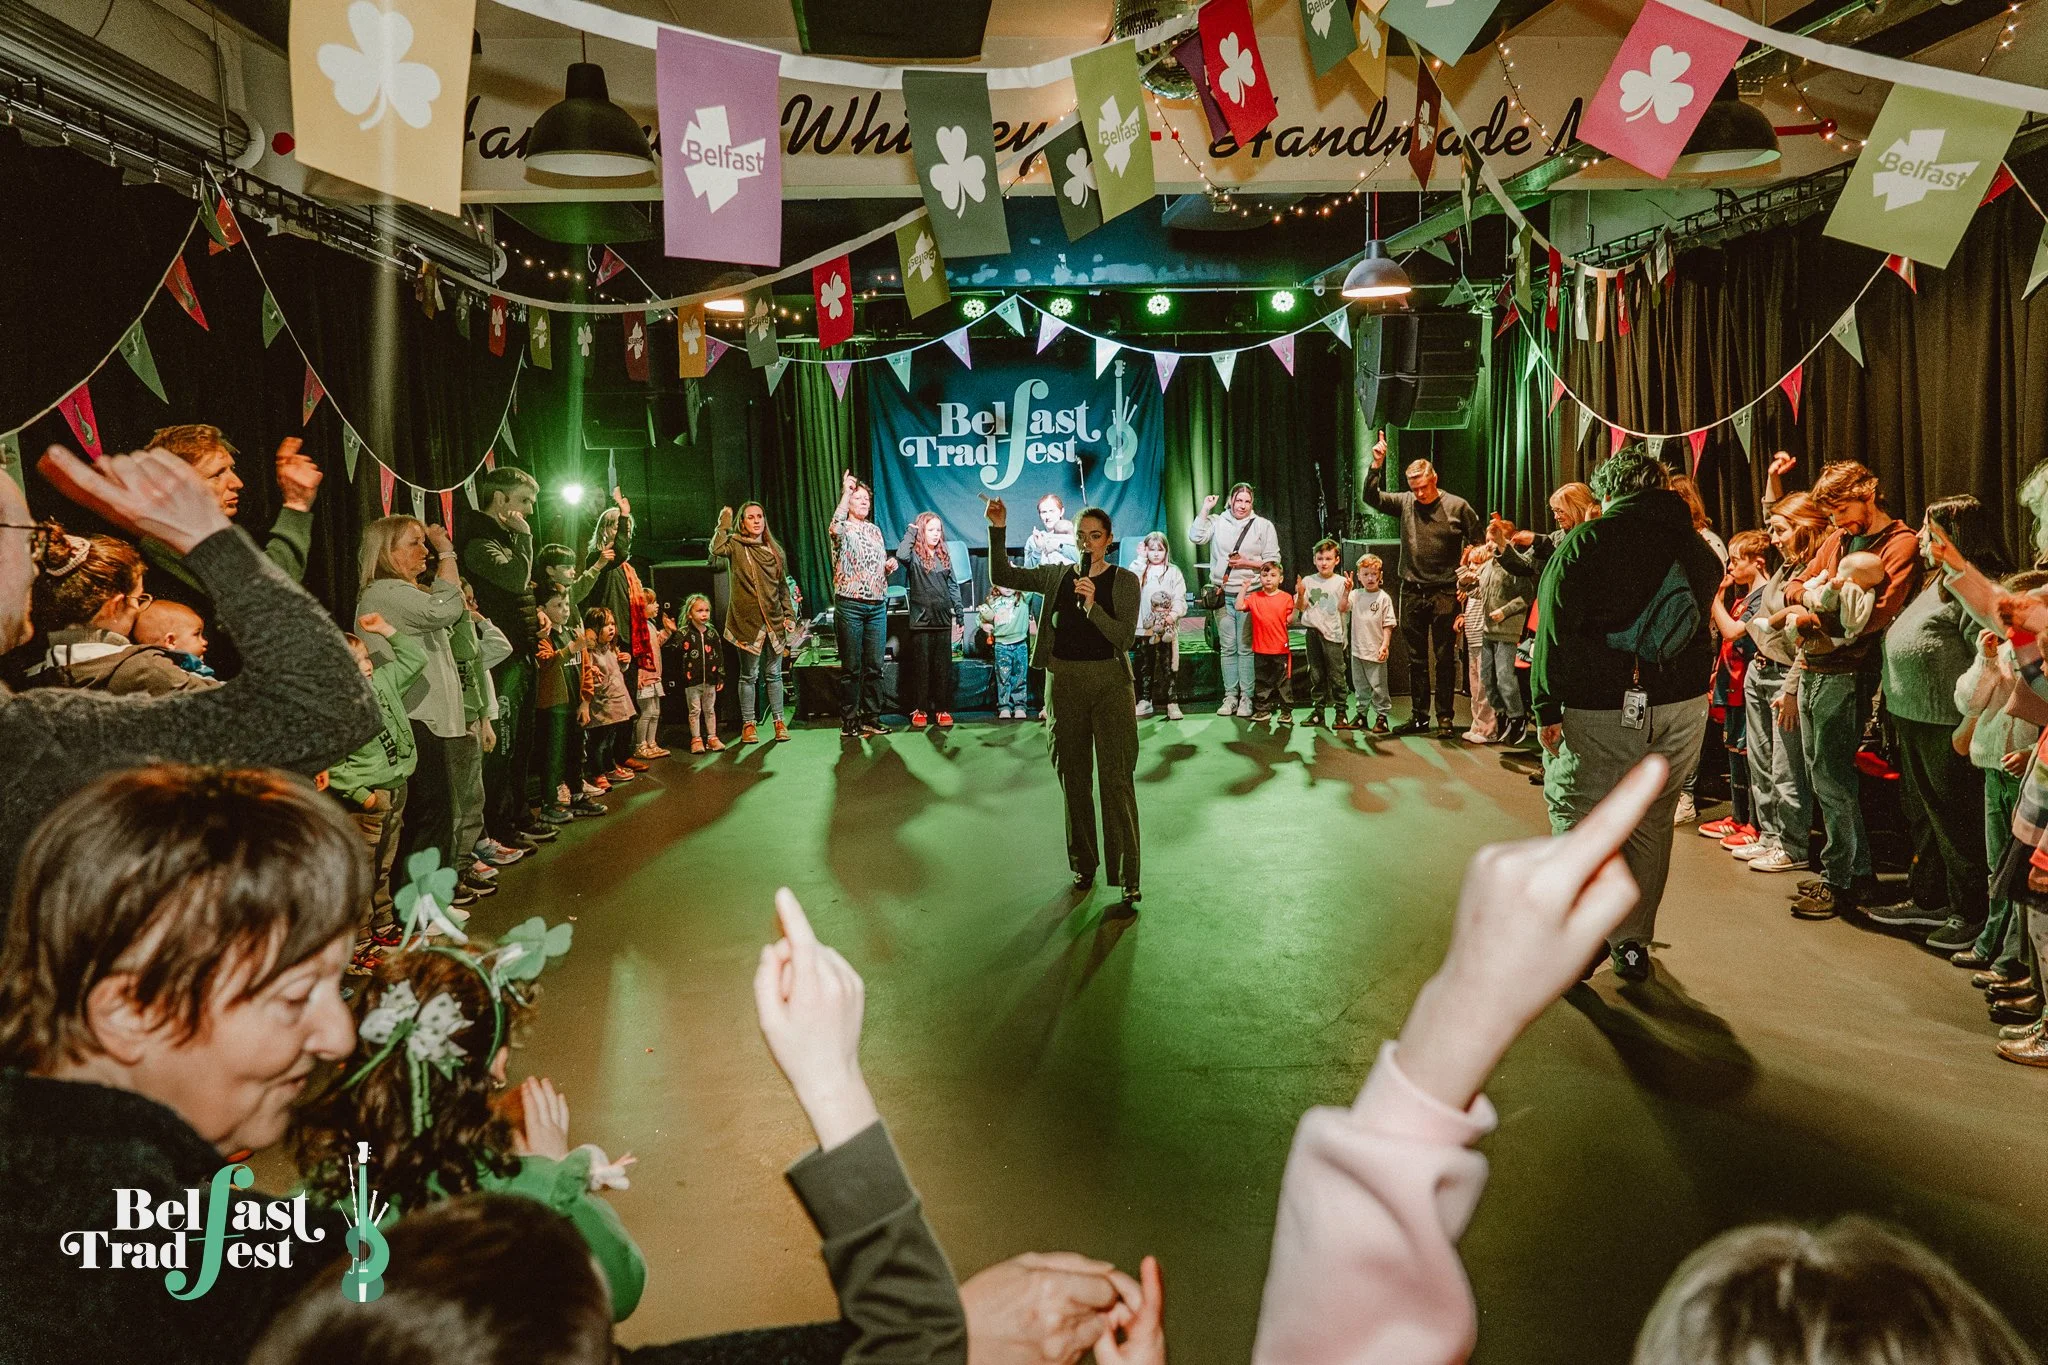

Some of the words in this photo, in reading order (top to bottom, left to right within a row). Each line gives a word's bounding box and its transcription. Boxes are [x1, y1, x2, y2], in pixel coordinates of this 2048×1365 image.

[1307, 0, 1335, 17] Belfa
[781, 91, 1048, 177] Whiey
[1100, 118, 1140, 147] Belfast
[687, 139, 764, 174] Belfast
[1883, 152, 1968, 190] Belfast
[937, 379, 1101, 490] Belfast
